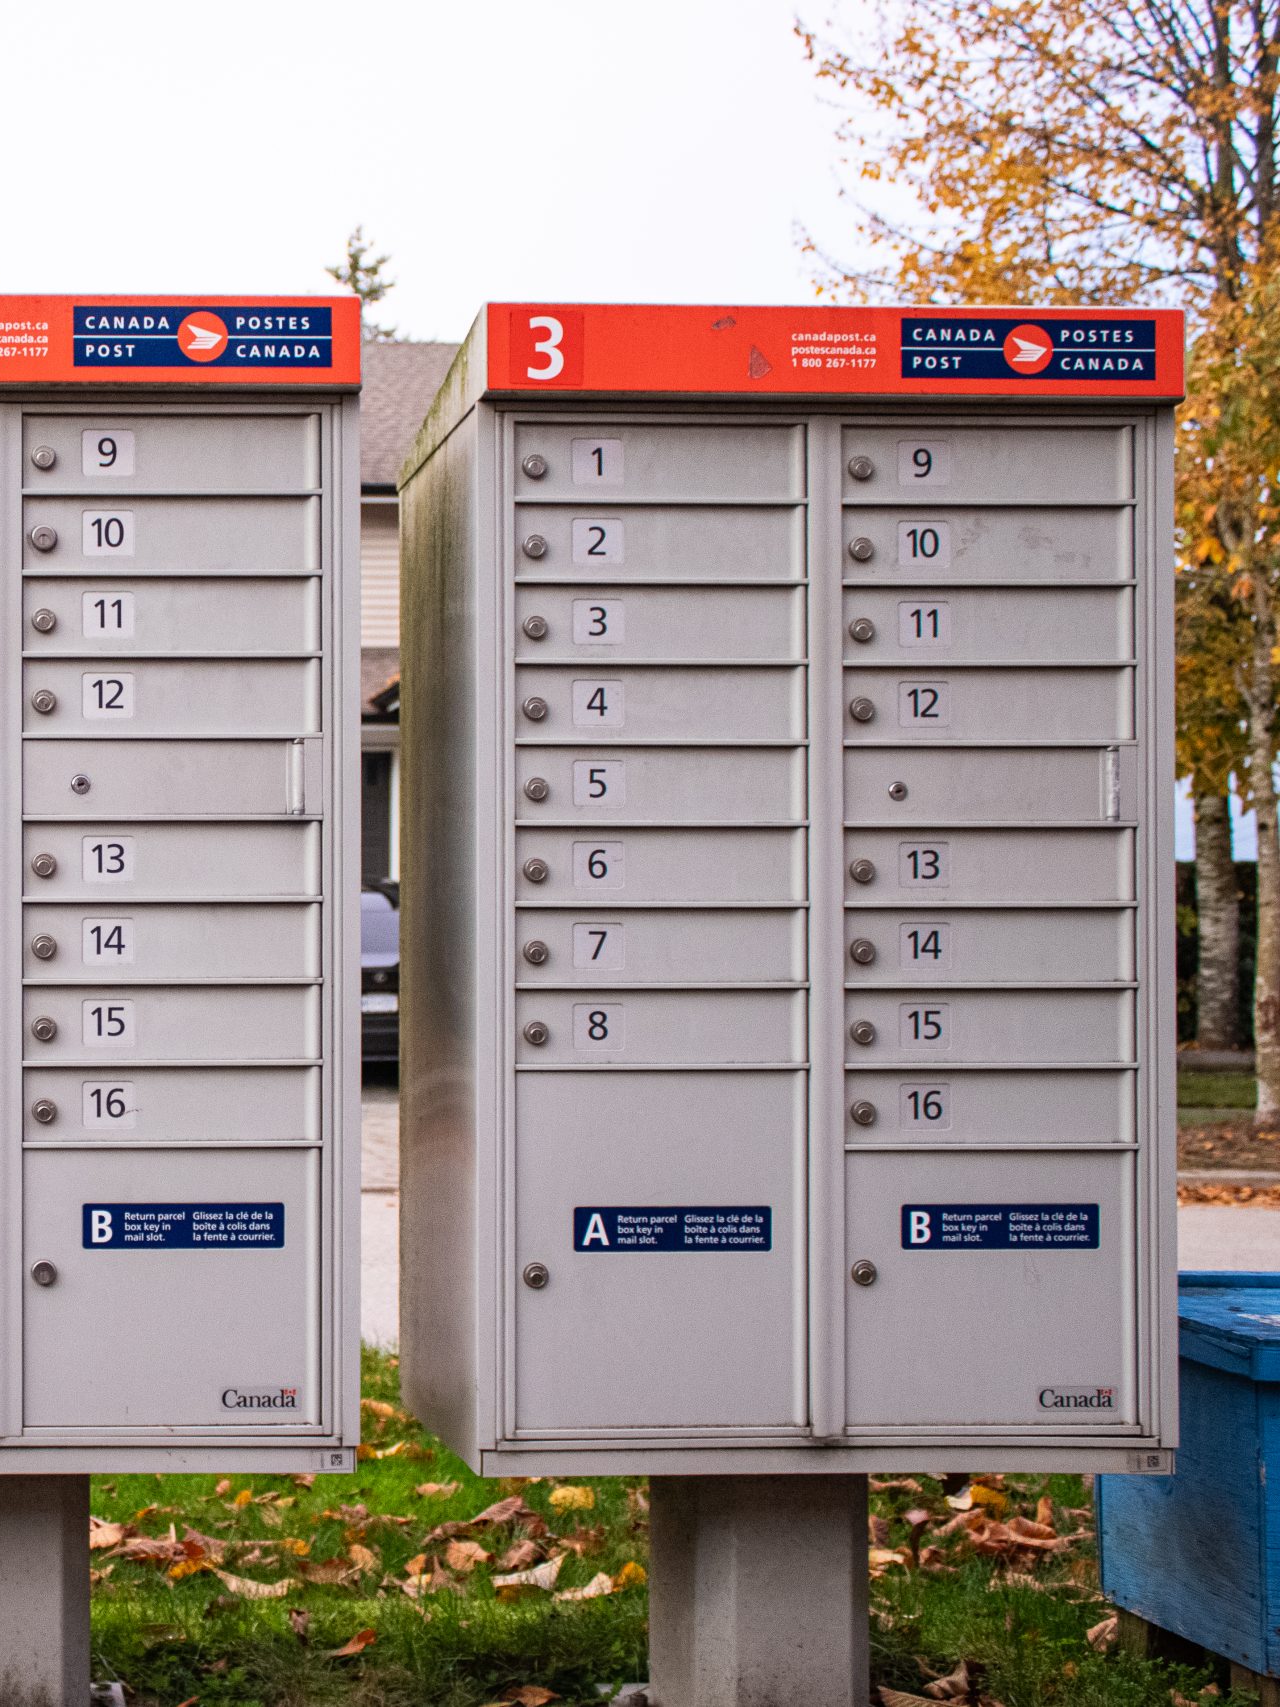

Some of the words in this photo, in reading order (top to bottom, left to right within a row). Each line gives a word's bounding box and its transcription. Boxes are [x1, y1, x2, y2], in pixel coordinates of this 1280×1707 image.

[85, 316, 170, 329] CANADA
[236, 316, 310, 330] POSTES
[791, 331, 876, 344] canadapost.ca
[913, 328, 995, 341] CANADA
[1060, 330, 1133, 343] POSTES
[86, 344, 135, 358] POST
[236, 344, 320, 358] CANADA
[527, 316, 564, 380] 3
[791, 345, 877, 356] postescanada.ca
[792, 358, 797, 367] 1
[802, 358, 822, 368] 800
[826, 358, 876, 368] 267-1177
[913, 356, 962, 369] POST
[1060, 357, 1144, 370] CANADA
[97, 437, 117, 468] 9
[591, 447, 603, 477] 1
[912, 447, 933, 478] 9
[91, 517, 124, 548] 10
[587, 526, 606, 556] 2
[906, 528, 940, 559] 10
[94, 599, 122, 629] 11
[588, 606, 607, 637] 3
[910, 608, 938, 638] 11
[92, 679, 124, 709] 12
[586, 687, 608, 717] 4
[907, 688, 939, 718] 12
[589, 768, 607, 799] 5
[91, 843, 125, 874] 13
[588, 849, 608, 880] 6
[906, 849, 940, 880] 13
[90, 925, 126, 955] 14
[588, 930, 607, 960] 7
[907, 930, 943, 960] 14
[91, 1006, 125, 1037] 15
[588, 1010, 608, 1041] 8
[907, 1010, 942, 1041] 15
[90, 1088, 126, 1118] 16
[907, 1089, 943, 1121] 16
[92, 1210, 113, 1243] B
[124, 1212, 156, 1220] Return
[158, 1211, 185, 1222] parcel
[124, 1222, 142, 1231] box
[143, 1222, 160, 1232] key
[192, 1211, 223, 1220] Glissez
[236, 1211, 249, 1220] clé
[226, 1222, 247, 1230] colis
[248, 1222, 270, 1230] dans
[582, 1213, 610, 1246] A
[617, 1215, 648, 1224] Return
[650, 1214, 678, 1224] parcel
[617, 1225, 634, 1234] box
[636, 1225, 652, 1235] key
[684, 1214, 714, 1224] Glissez
[726, 1214, 740, 1223] clé
[717, 1224, 738, 1234] colis
[739, 1225, 761, 1234] dans
[910, 1211, 931, 1244] B
[124, 1232, 144, 1242] mail
[146, 1232, 165, 1242] slot.
[203, 1232, 228, 1241] fente
[238, 1232, 275, 1241] courrier.
[617, 1235, 637, 1244] mail
[638, 1235, 658, 1244] slot.
[694, 1234, 719, 1244] fente
[728, 1236, 765, 1244] courrier.
[222, 1389, 296, 1408] Canada
[1039, 1388, 1113, 1408] Canada
